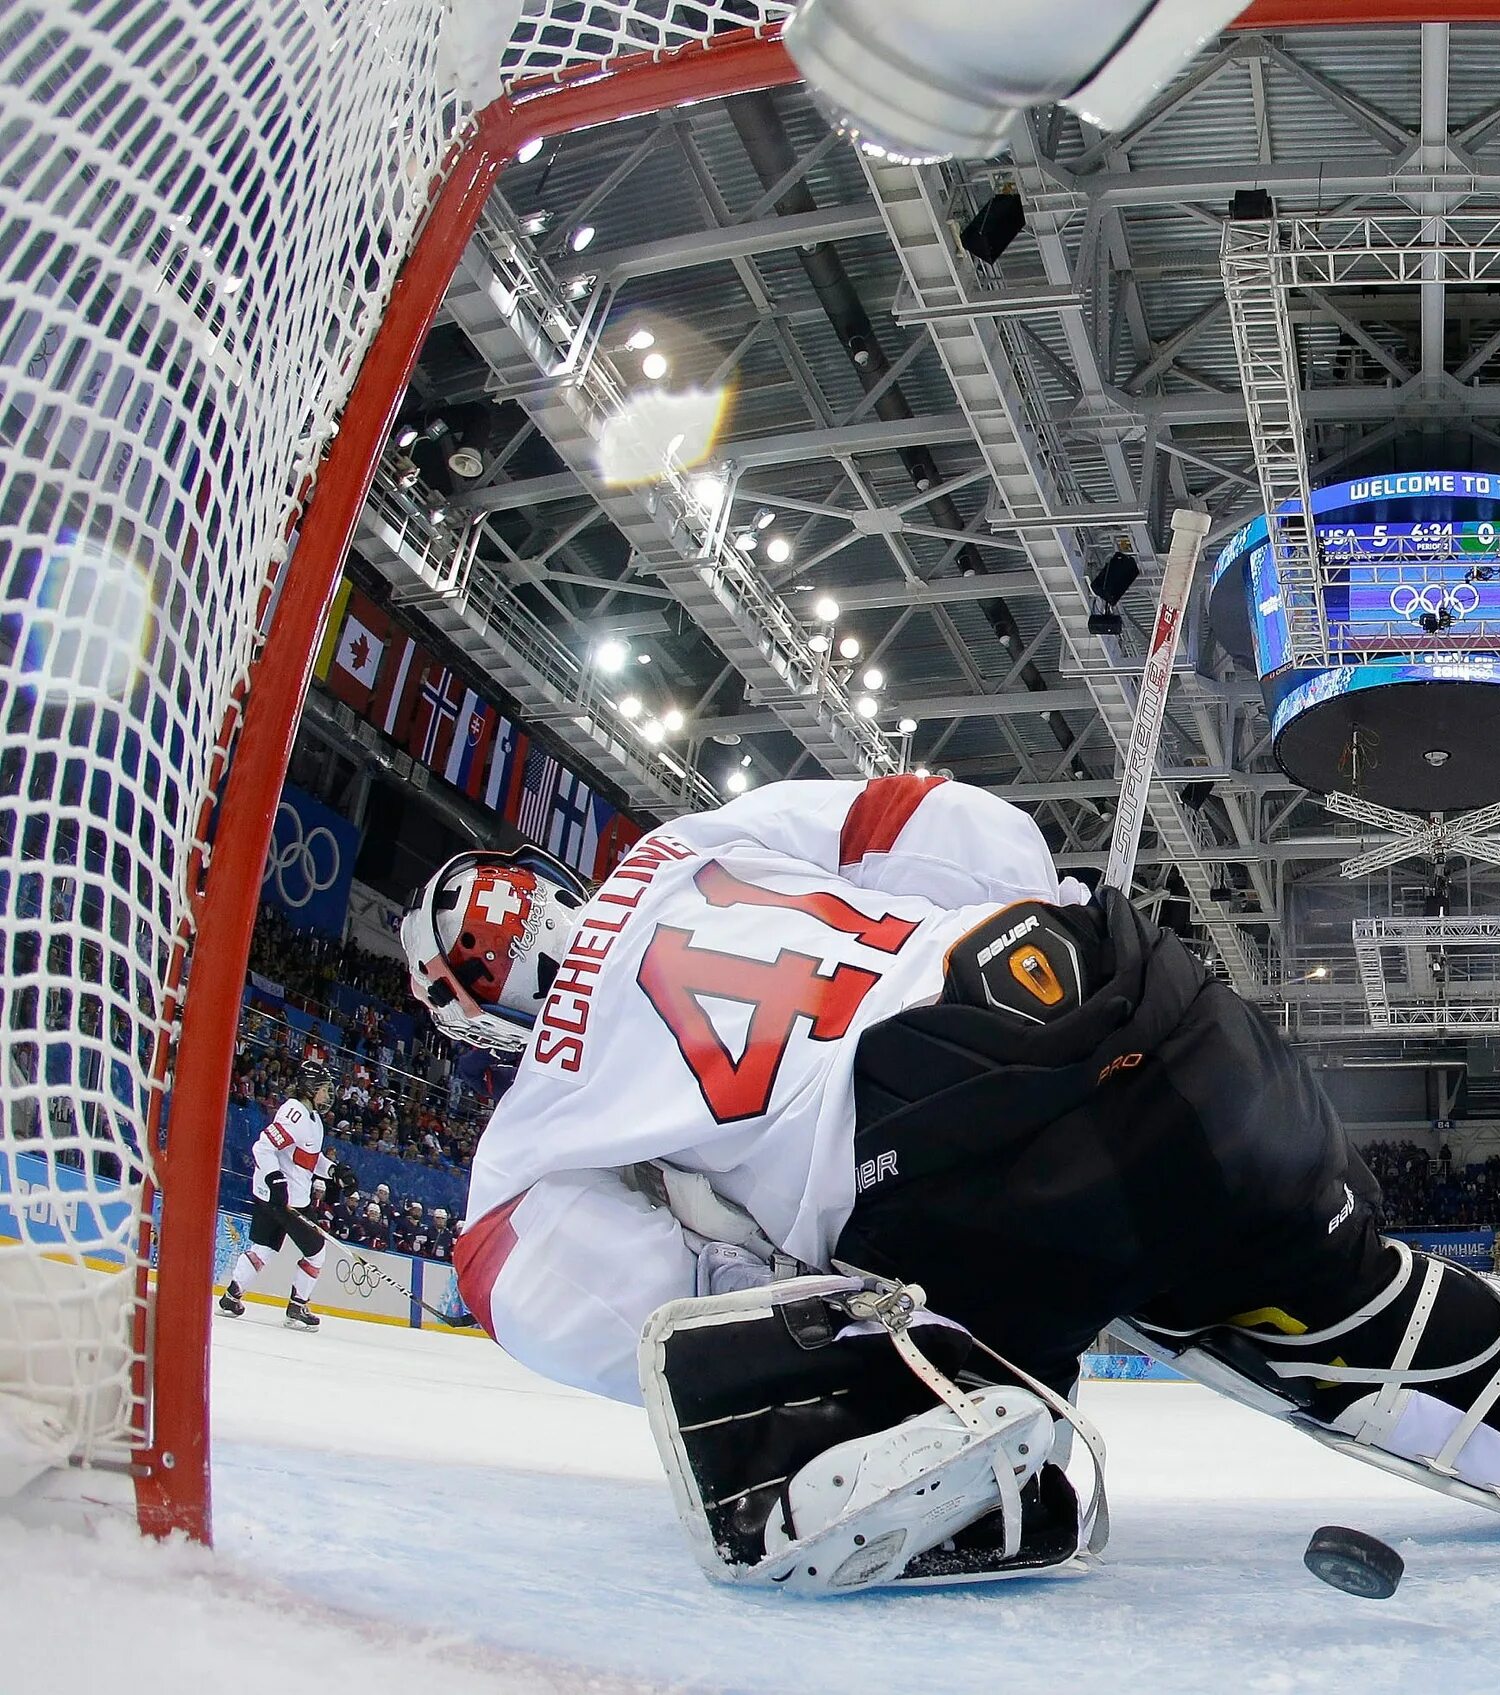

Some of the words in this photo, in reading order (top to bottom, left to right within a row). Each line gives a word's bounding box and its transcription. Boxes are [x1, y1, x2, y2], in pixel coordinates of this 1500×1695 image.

[1350, 475, 1454, 500] WELCOME
[1461, 476, 1490, 494] TO
[1320, 528, 1356, 545] USA
[1373, 525, 1388, 546] 5
[1410, 523, 1453, 542] 6:34
[1477, 524, 1495, 545] 0
[1114, 663, 1162, 865] SUPREME
[976, 915, 1040, 968] BAUER
[535, 836, 700, 1073] SCHELLING
[636, 858, 924, 1125] 41
[1097, 1053, 1143, 1086] PRO
[285, 1107, 302, 1124] 10
[1437, 1121, 1450, 1129] B4
[1430, 1243, 1485, 1256] ЗИМНИЕ
